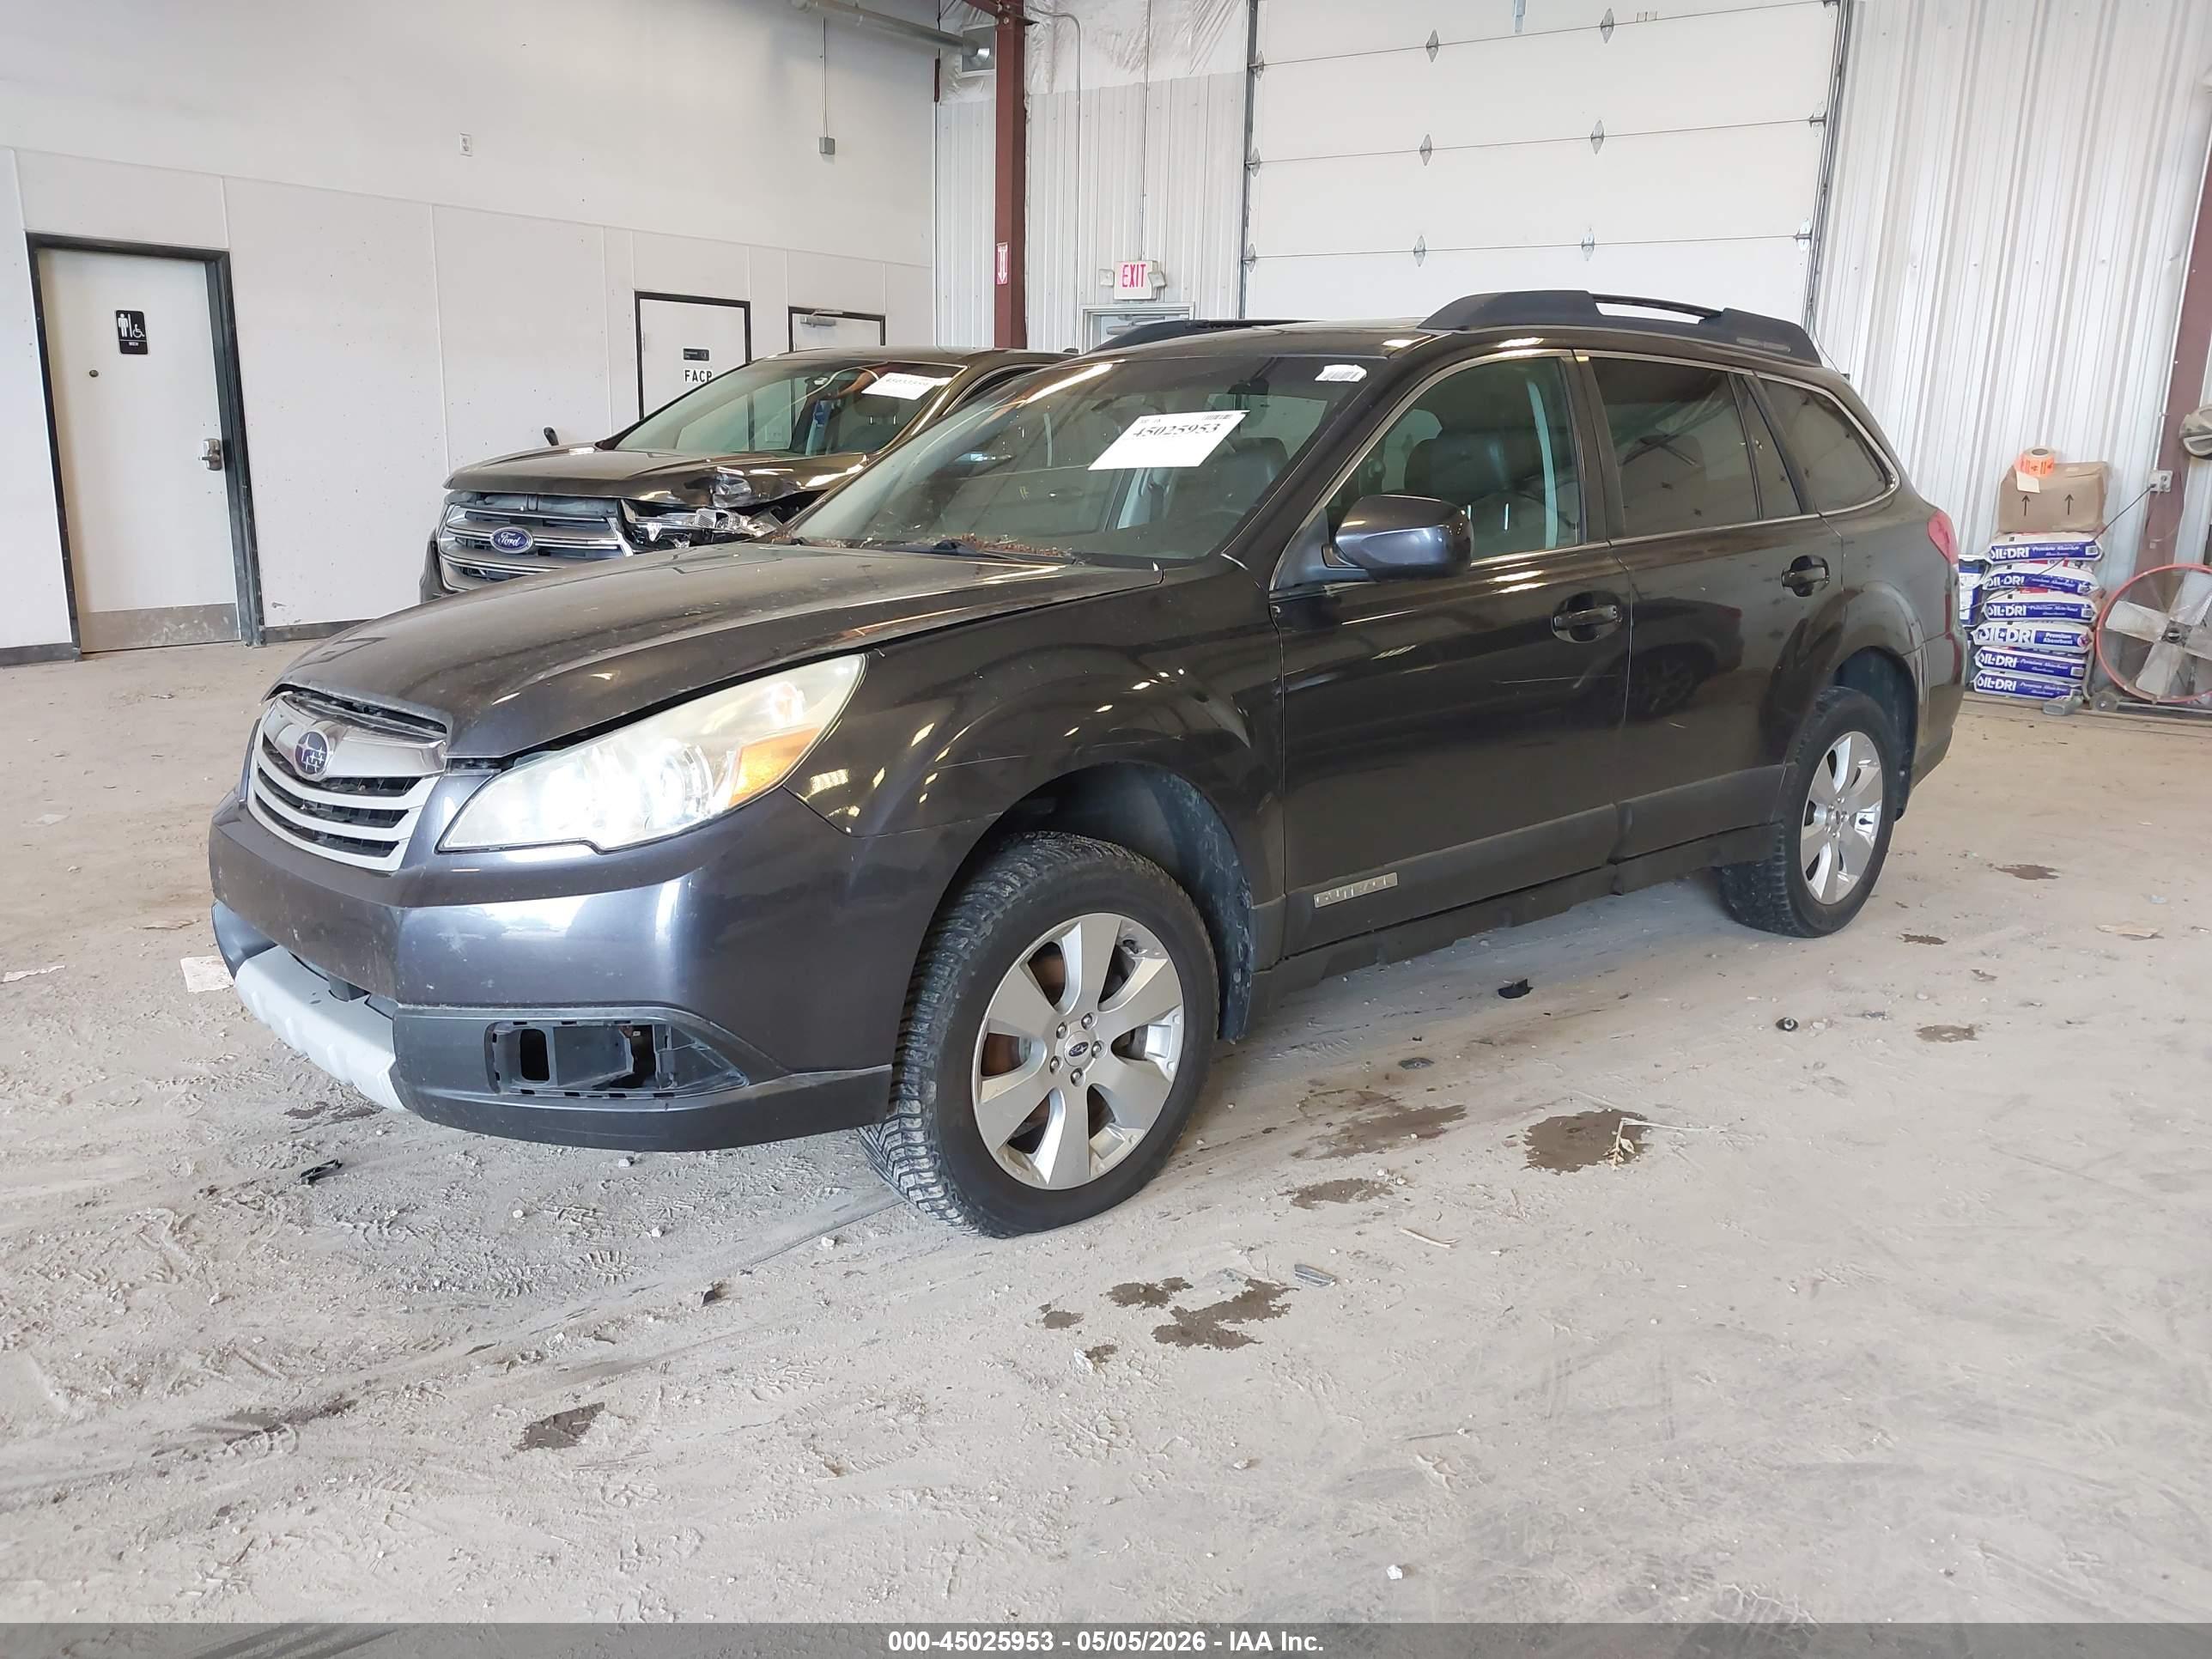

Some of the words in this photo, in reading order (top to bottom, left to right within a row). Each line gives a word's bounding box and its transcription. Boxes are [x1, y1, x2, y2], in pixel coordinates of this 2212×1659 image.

[1121, 264, 1146, 288] EXIT
[684, 369, 713, 383] FACP
[498, 532, 522, 547] Ford
